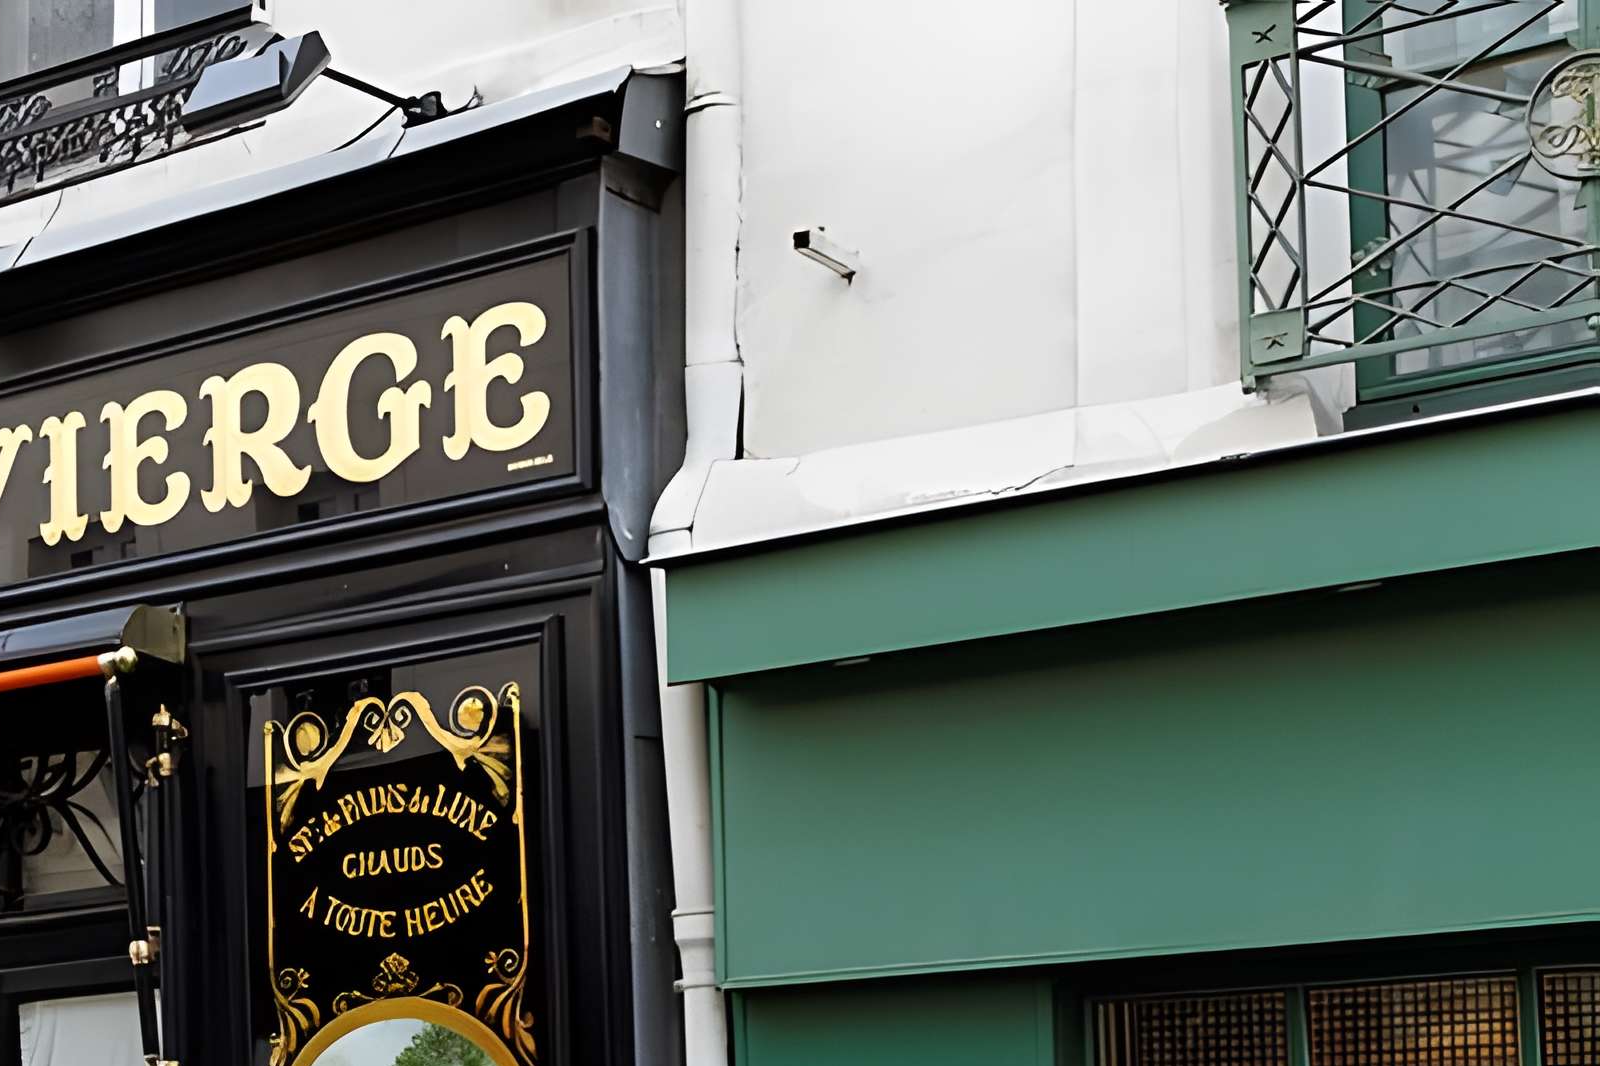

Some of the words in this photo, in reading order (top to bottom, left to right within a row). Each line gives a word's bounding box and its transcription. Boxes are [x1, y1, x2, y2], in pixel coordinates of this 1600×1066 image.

[432, 784, 498, 841] LUXE
[342, 843, 444, 879] CHAUDS
[300, 886, 319, 919] A
[324, 896, 397, 938] TOUTE
[405, 869, 494, 938] HEURE
